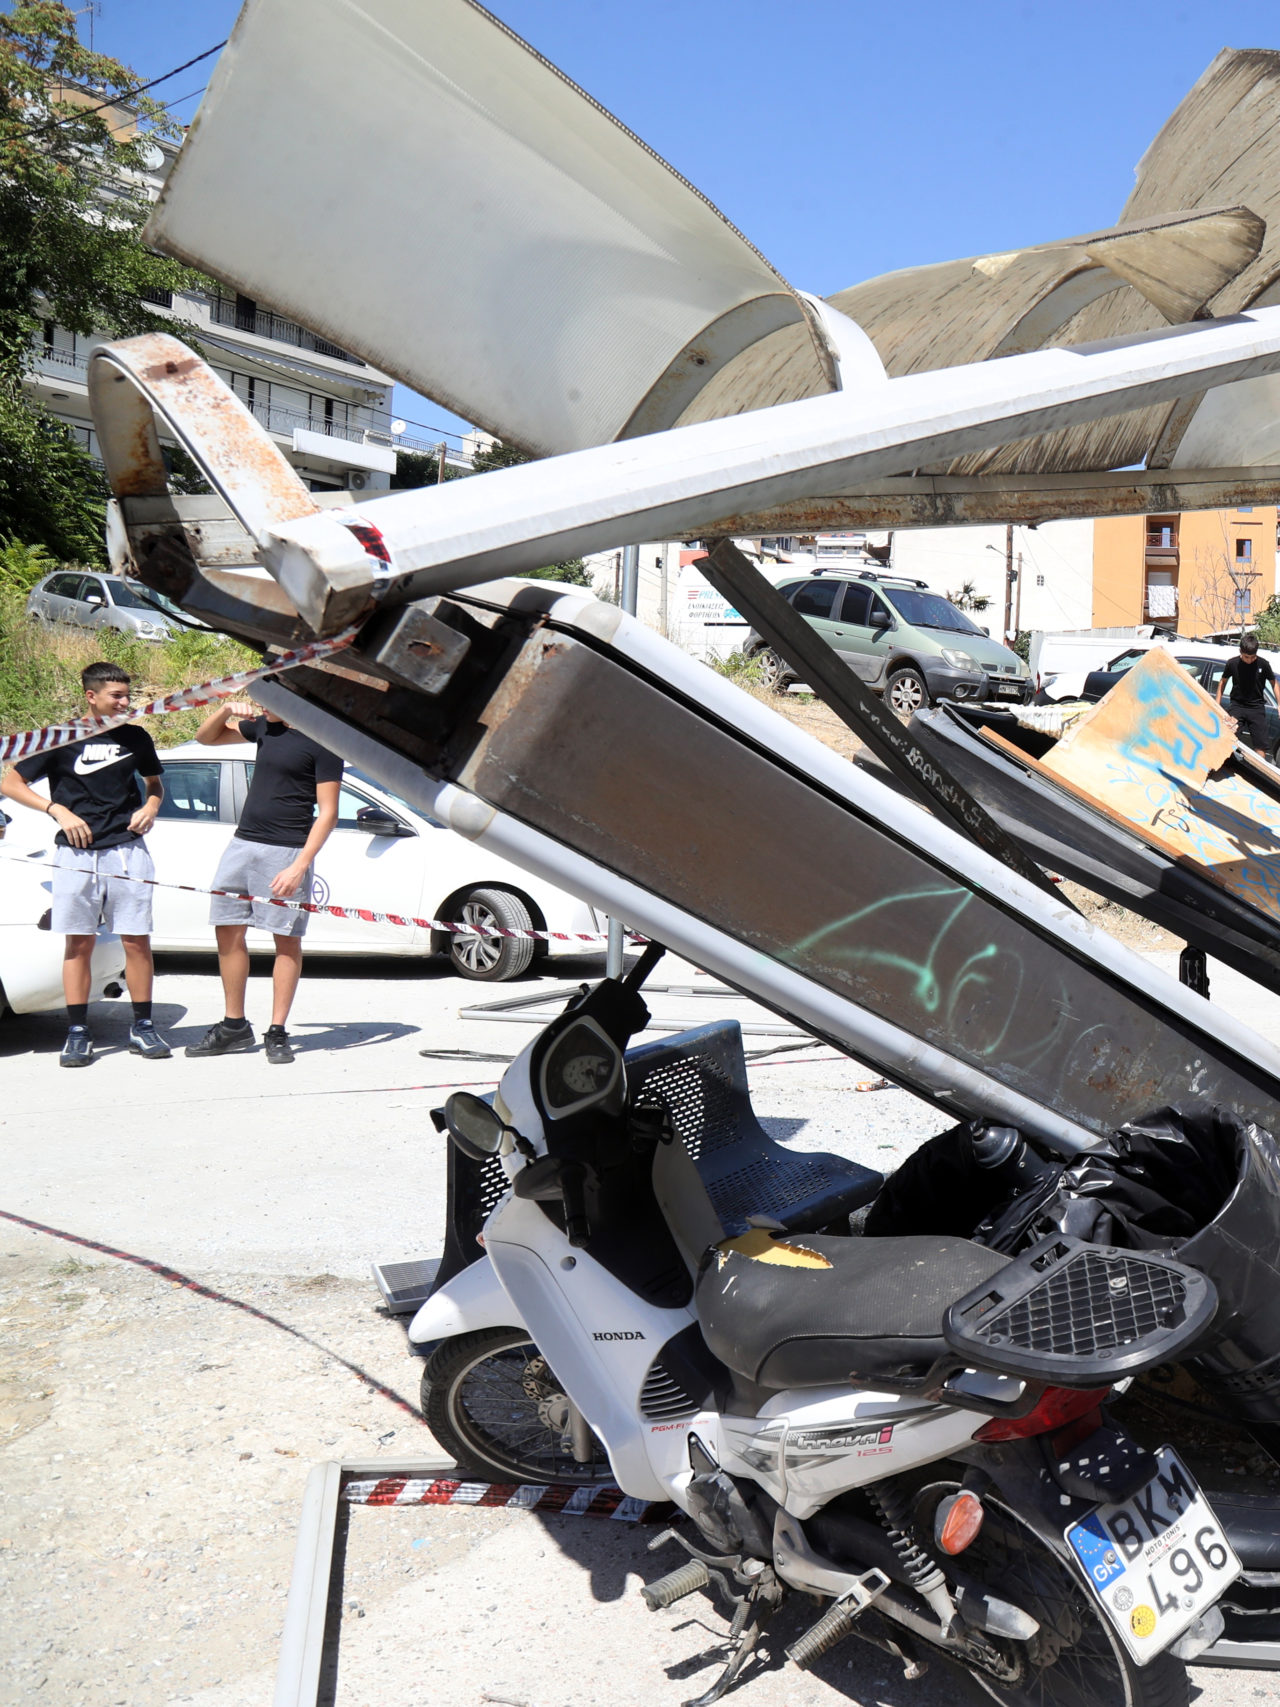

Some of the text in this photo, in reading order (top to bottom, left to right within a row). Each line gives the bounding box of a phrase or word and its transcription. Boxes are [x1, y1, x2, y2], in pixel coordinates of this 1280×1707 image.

[82, 743, 121, 761] NIKE
[592, 1331, 646, 1341] HONDA
[857, 1445, 893, 1457] 125
[1106, 1461, 1198, 1565] BKM
[1144, 1537, 1164, 1557] MOTO
[1162, 1524, 1181, 1543] TONIS
[1147, 1525, 1228, 1618] 496
